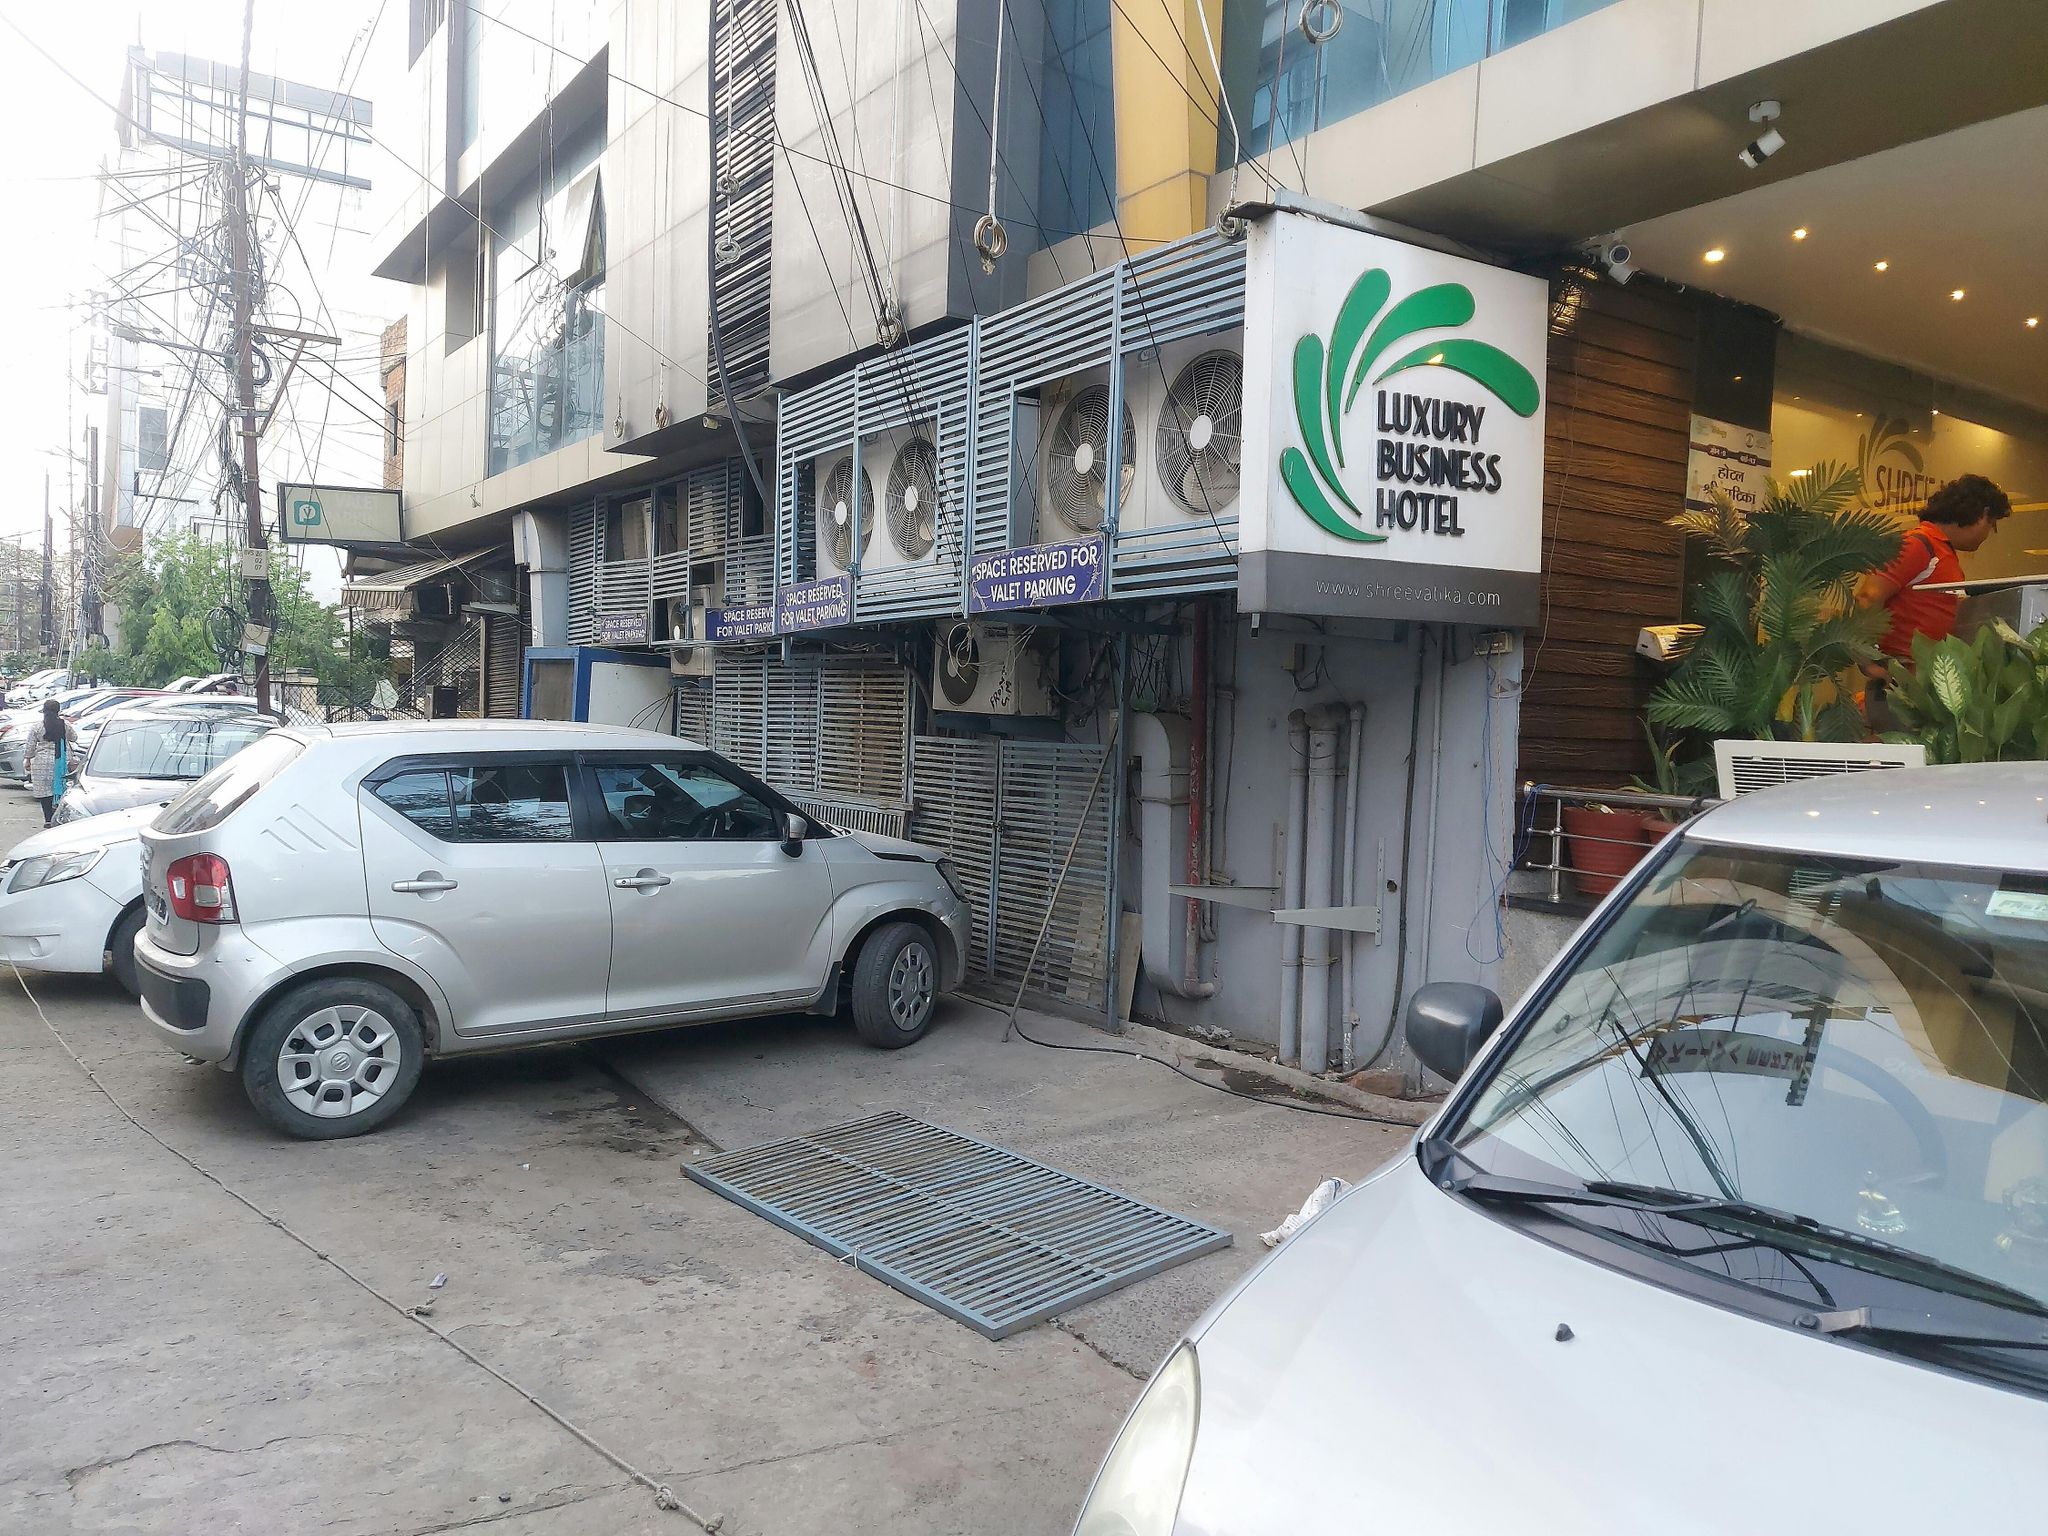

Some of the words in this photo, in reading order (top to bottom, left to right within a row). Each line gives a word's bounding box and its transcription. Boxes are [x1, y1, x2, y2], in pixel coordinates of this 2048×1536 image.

[1378, 390, 1486, 445] LUXURY
[1377, 439, 1502, 494] BUSINESS
[1377, 488, 1465, 536] HOTEL
[976, 560, 1006, 580] SPACE
[1010, 551, 1067, 575] RESERVED
[1070, 545, 1098, 568] FOR
[785, 590, 806, 607] SPACE
[808, 584, 842, 603] RESERVED
[991, 582, 1021, 602] VALET
[1024, 575, 1077, 598] PARKING
[723, 610, 745, 623] SPACE
[746, 607, 773, 620] RESERVE
[781, 611, 794, 626] FOR
[795, 607, 816, 623] VALET
[816, 602, 847, 621] PARKING
[716, 626, 733, 637] FOR
[734, 623, 753, 636] VALET
